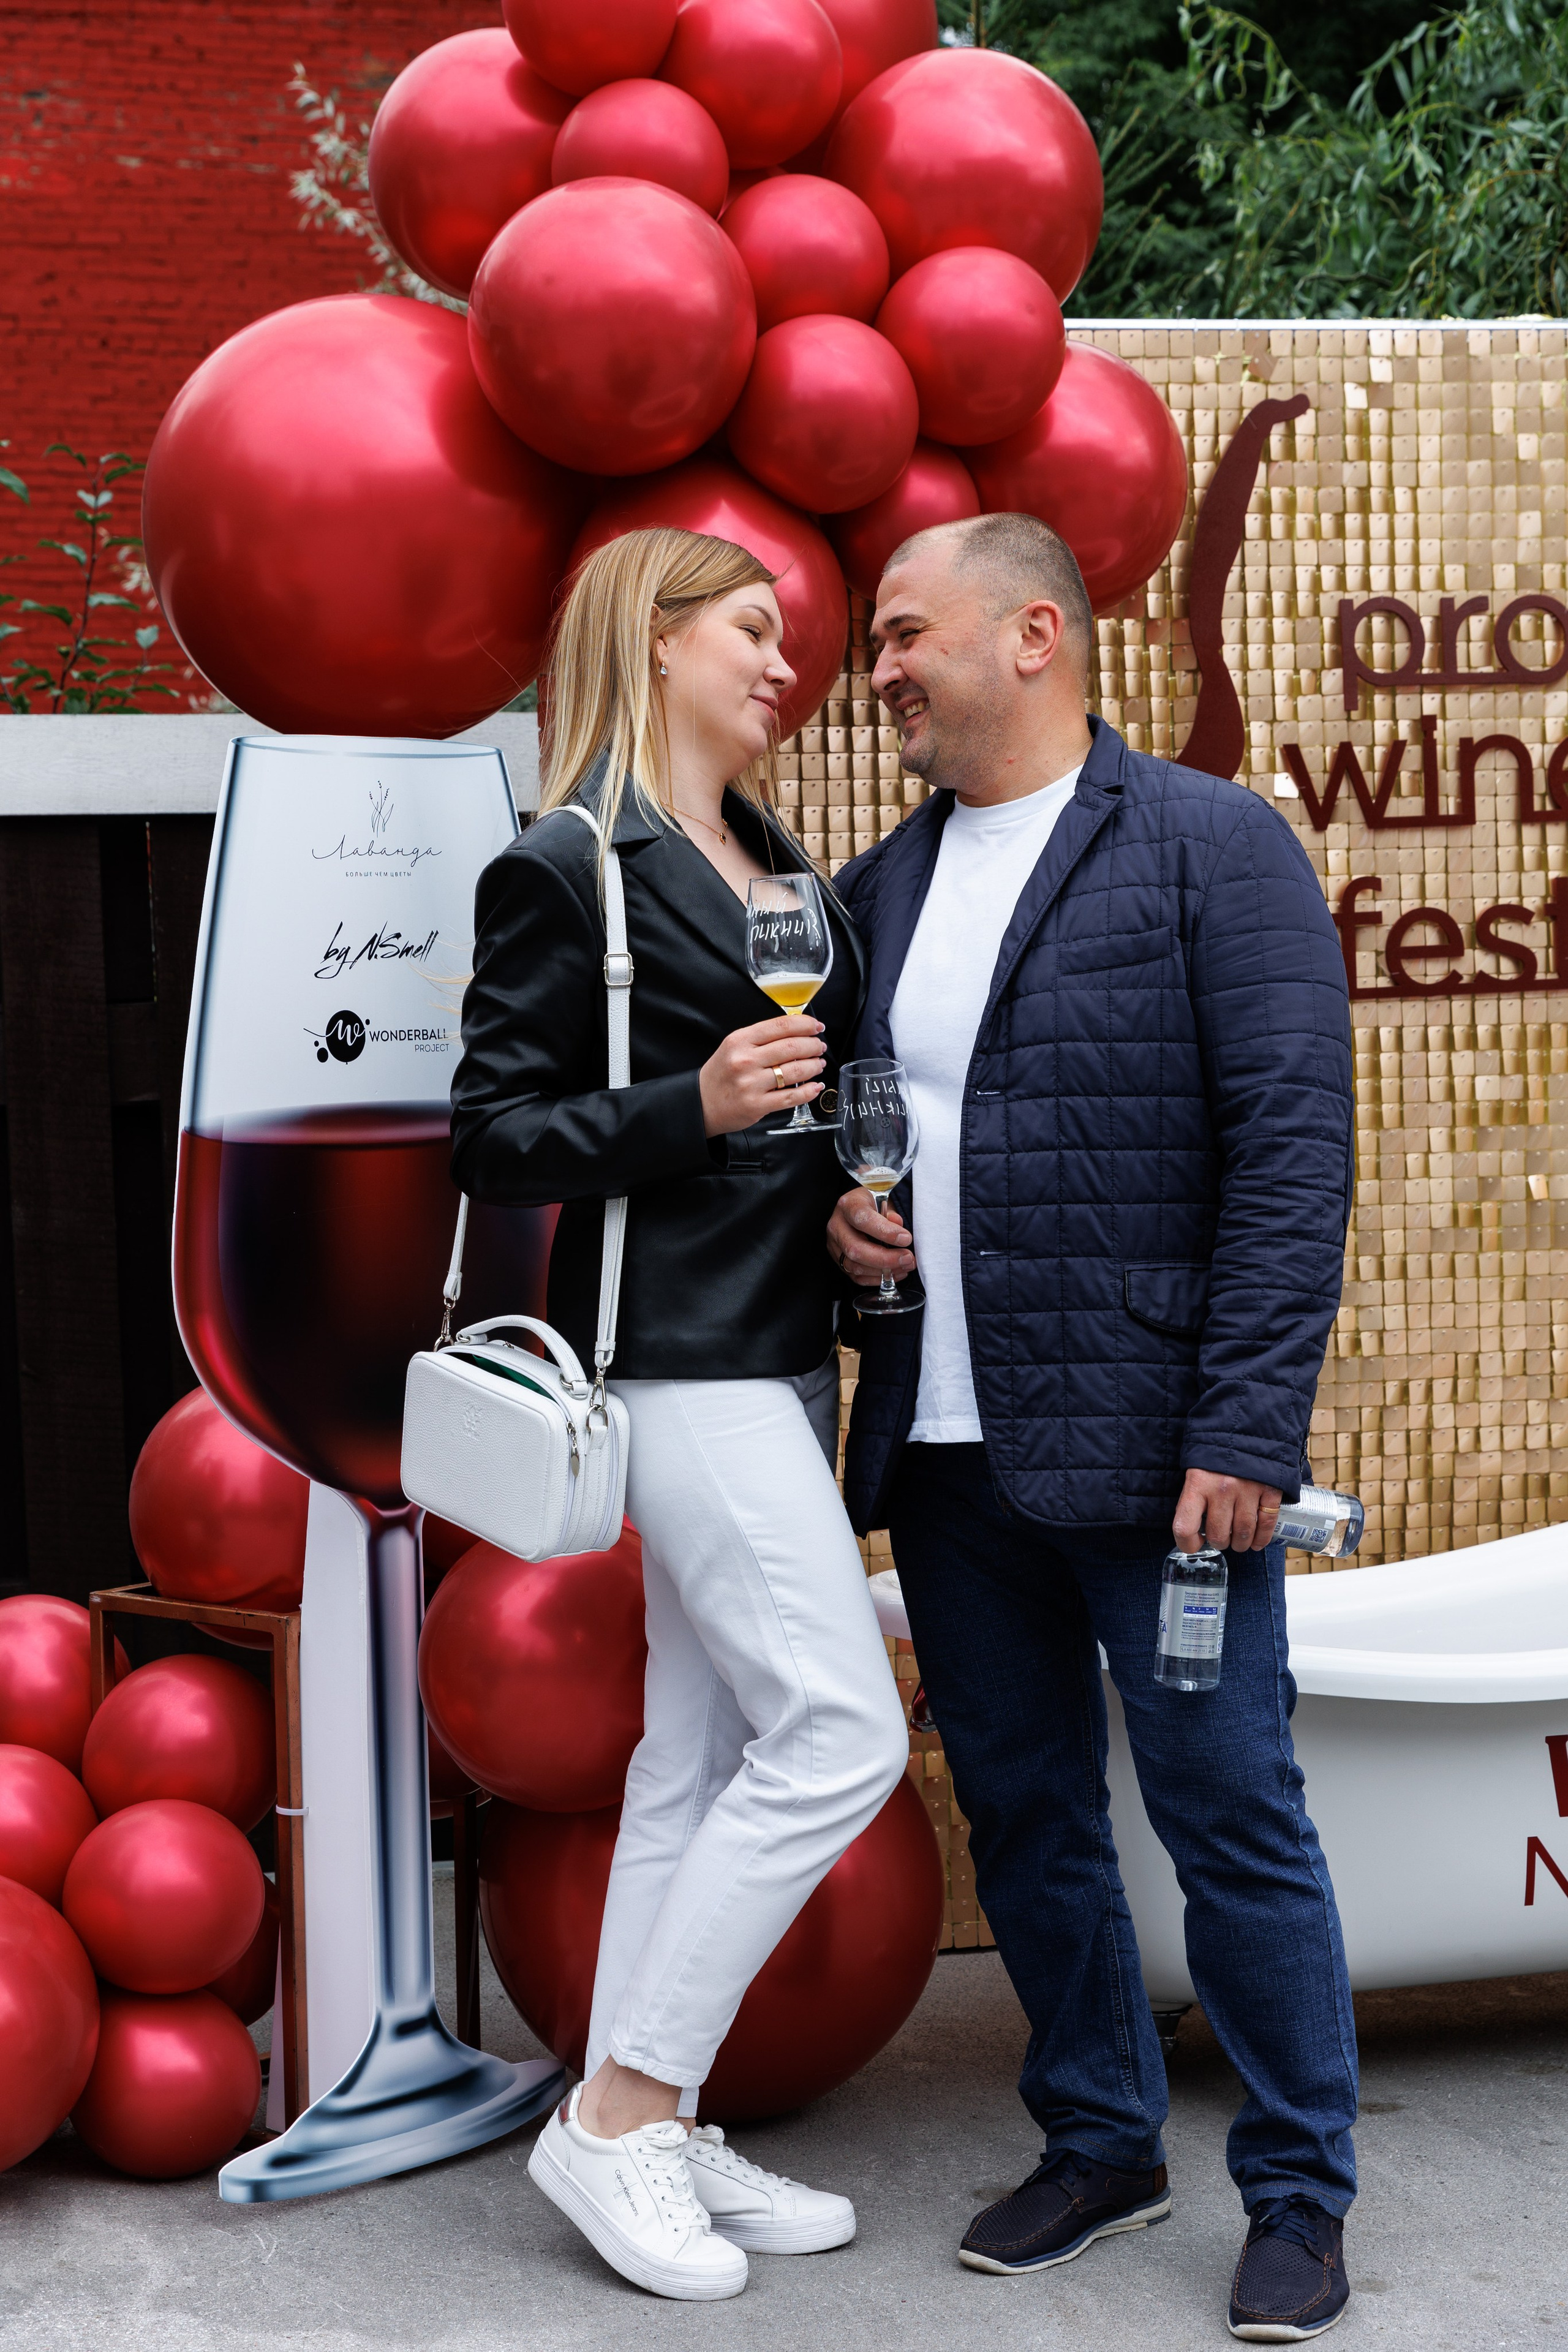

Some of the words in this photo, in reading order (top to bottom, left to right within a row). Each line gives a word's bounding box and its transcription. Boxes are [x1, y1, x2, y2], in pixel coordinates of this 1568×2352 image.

[1338, 594, 1568, 711] pro
[1283, 714, 1568, 832] win
[312, 834, 442, 867] Лаванда
[314, 921, 351, 979] by
[369, 1028, 449, 1042] WONDERBALL
[414, 1043, 450, 1052] PROJECT
[614, 2169, 625, 2187] Calvin
[622, 2186, 631, 2201] Klein
[628, 2201, 639, 2217] Jeans
